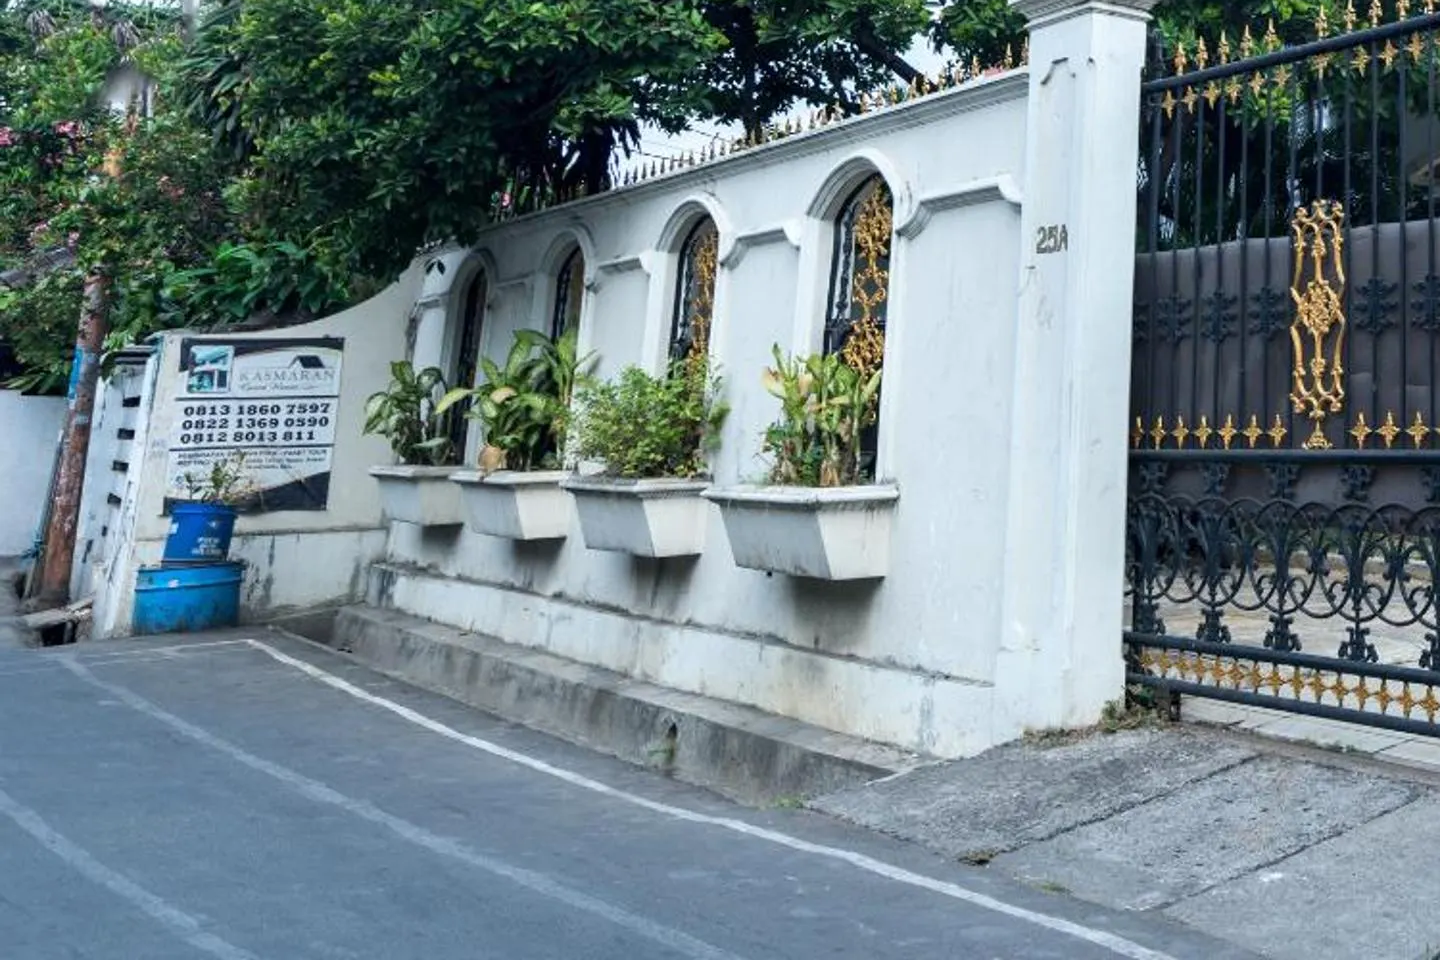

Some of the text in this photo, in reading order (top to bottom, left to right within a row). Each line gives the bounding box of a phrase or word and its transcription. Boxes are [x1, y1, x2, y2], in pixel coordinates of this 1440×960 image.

[1036, 224, 1068, 254] 25A
[239, 368, 336, 382] KASMARAN
[184, 403, 331, 416] 0813 1860 7597
[182, 418, 229, 430] 0822
[284, 416, 329, 427] 0590
[180, 430, 315, 444] 0812 8013 811
